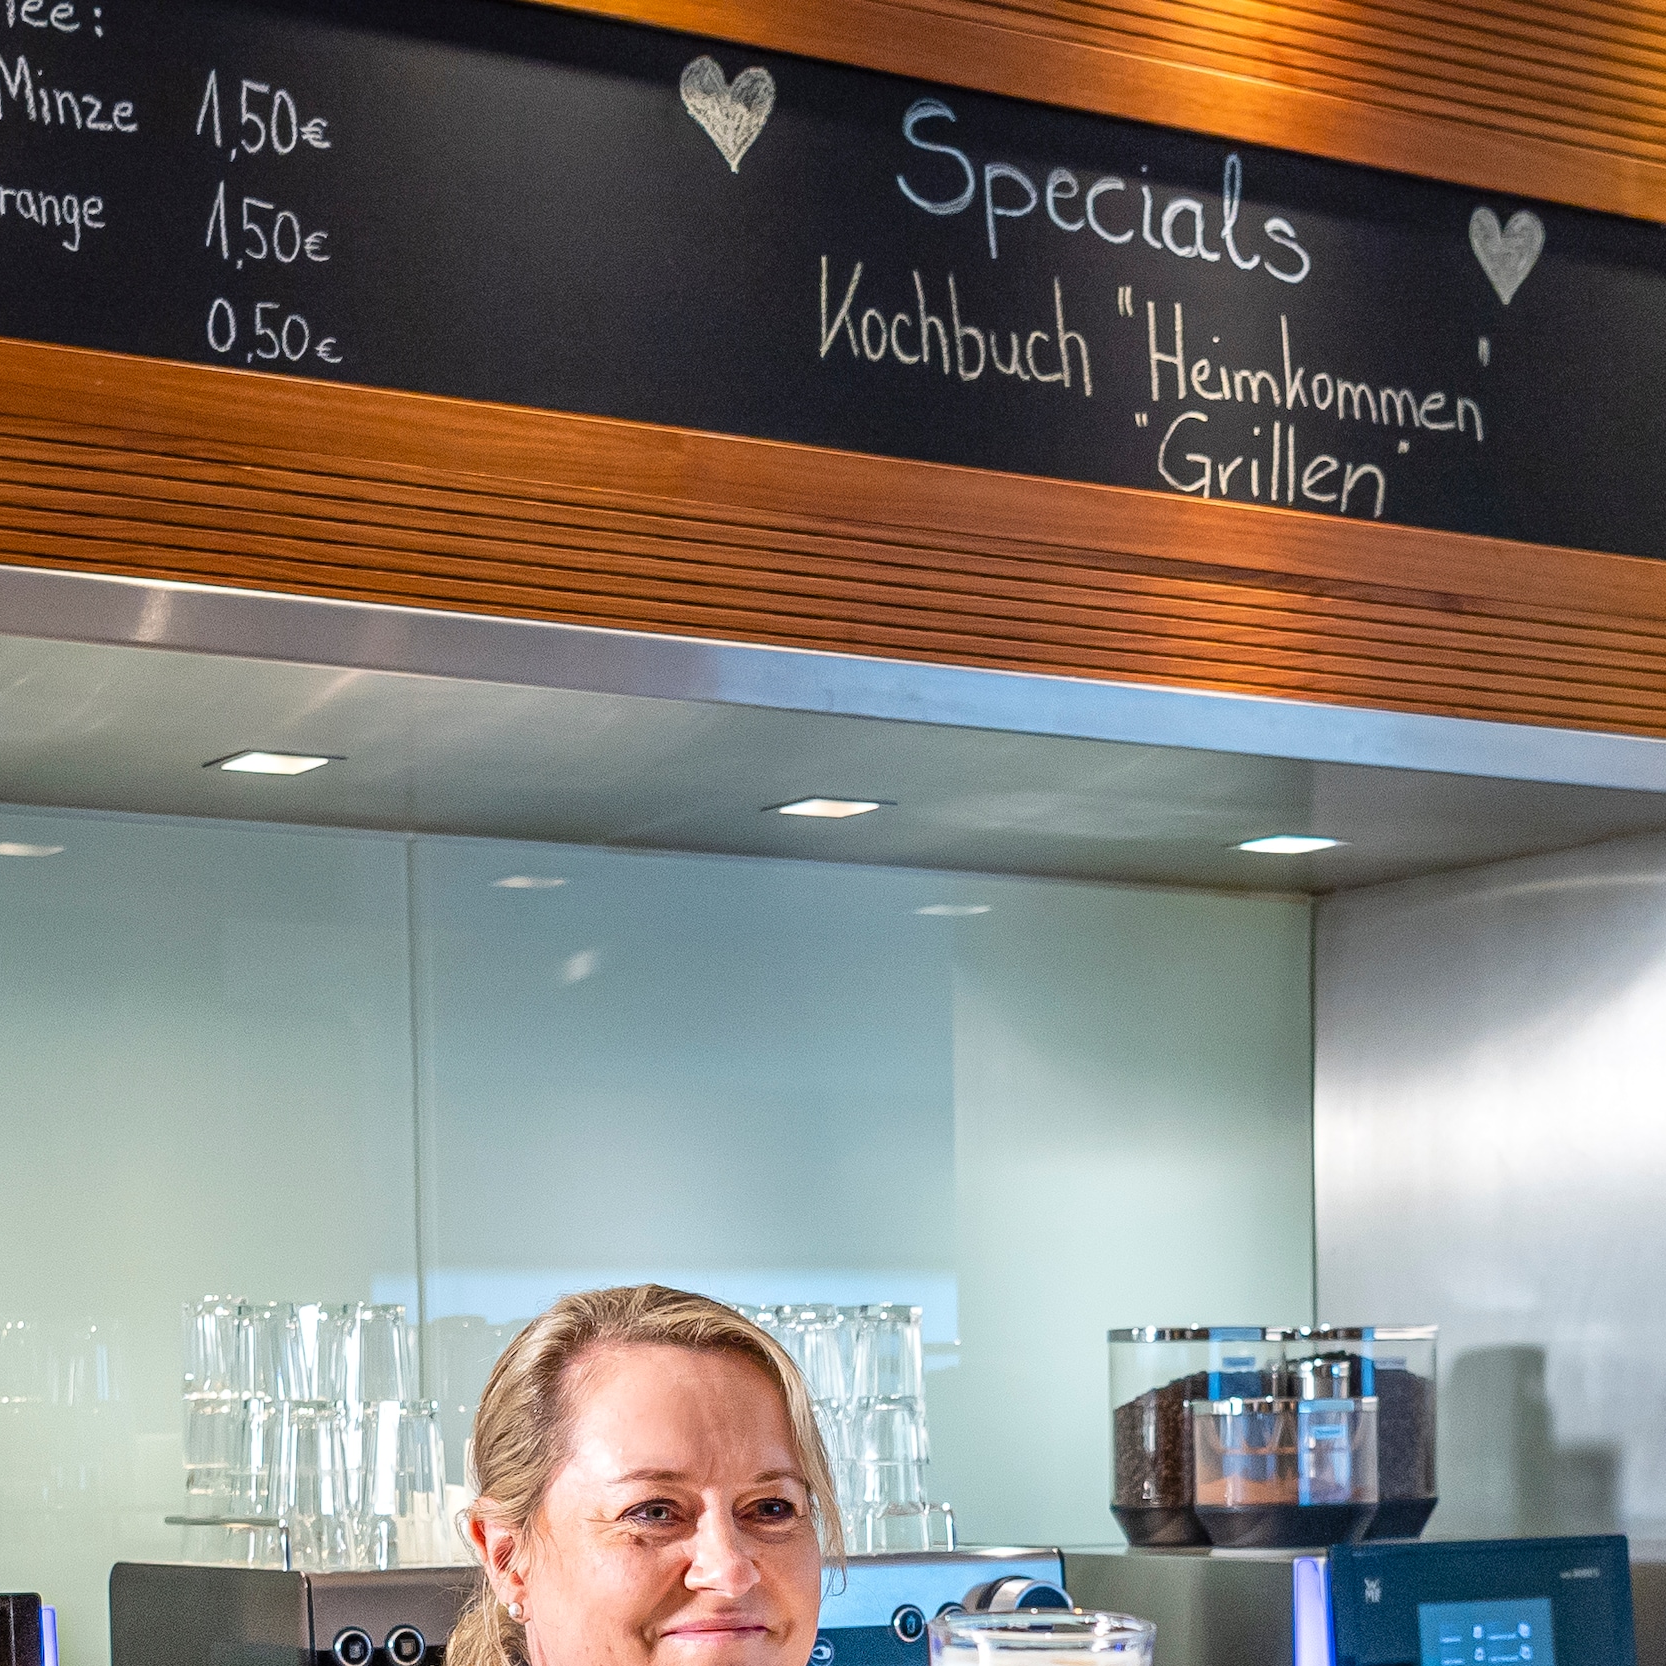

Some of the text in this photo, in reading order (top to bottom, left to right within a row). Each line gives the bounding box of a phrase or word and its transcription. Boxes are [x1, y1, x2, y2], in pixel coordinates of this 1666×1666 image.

[195, 69, 331, 162] 1,50€
[205, 180, 331, 269] 1,50€
[895, 95, 1312, 285] Specials
[206, 298, 343, 364] 0,50€
[818, 254, 1094, 398] Kochbuch
